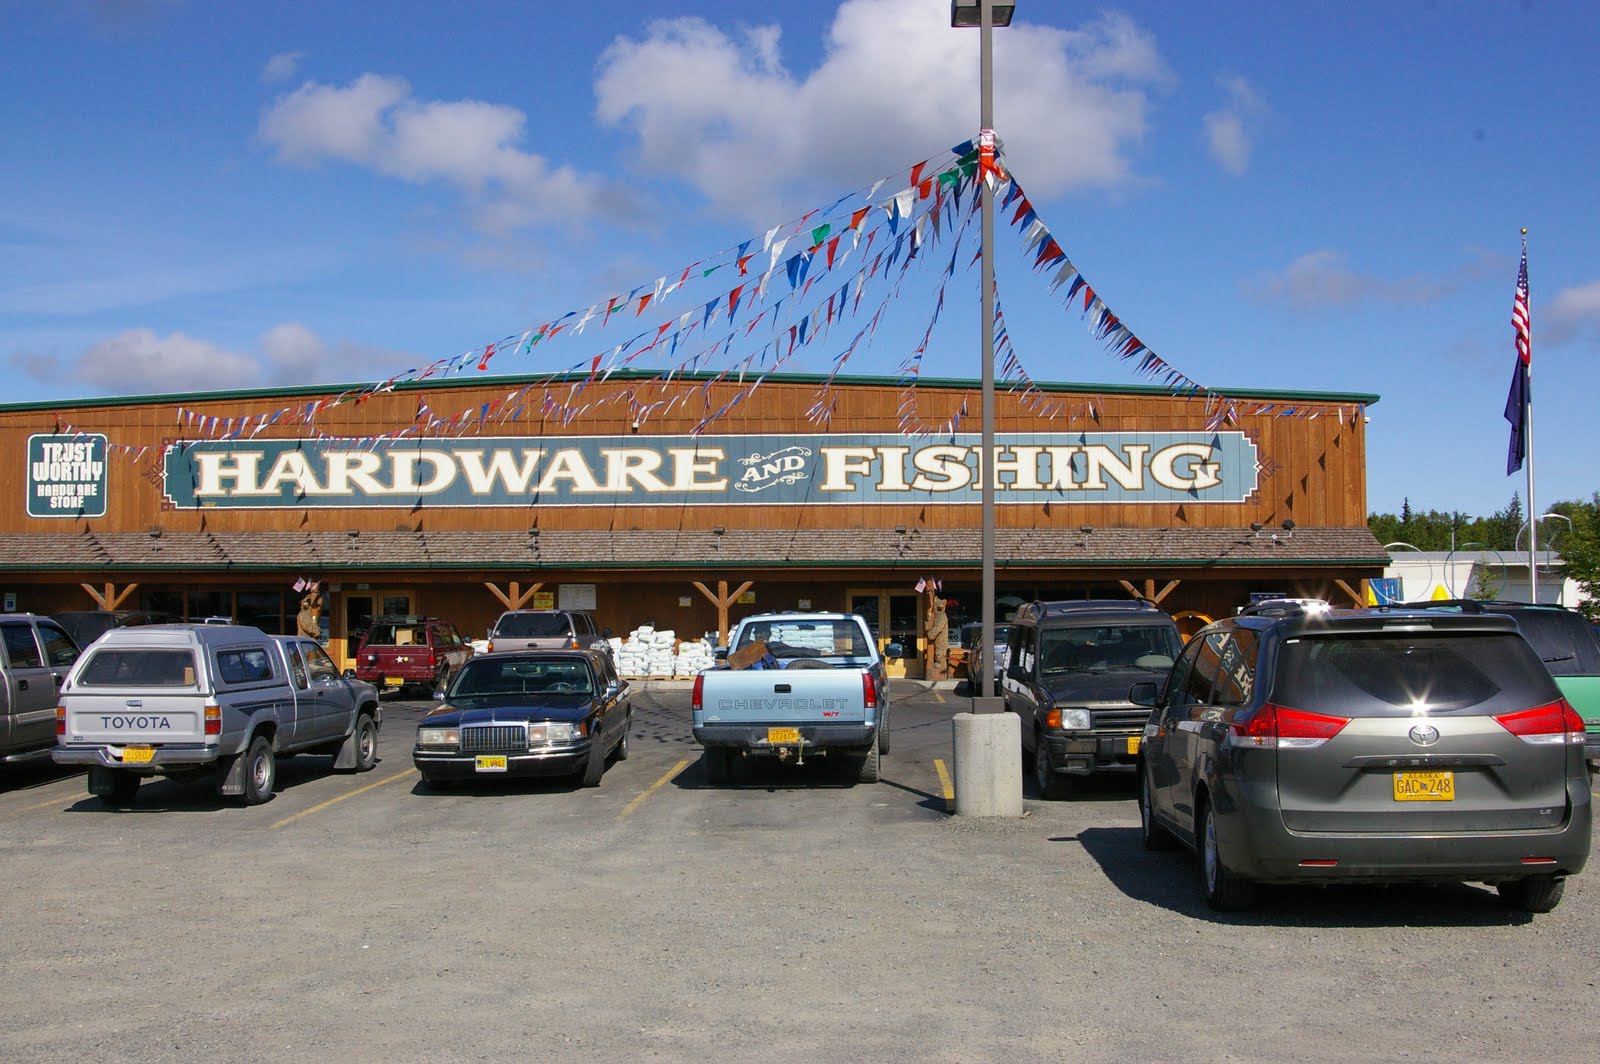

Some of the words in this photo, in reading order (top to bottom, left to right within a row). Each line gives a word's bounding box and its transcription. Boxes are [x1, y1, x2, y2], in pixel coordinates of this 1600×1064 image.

[42, 443, 95, 463] TRUST
[32, 461, 103, 482] WORTHY
[194, 448, 727, 497] HARDWARE
[741, 455, 806, 482] AND
[819, 444, 1223, 491] FISHING
[37, 484, 98, 497] HARDWARE
[50, 496, 84, 509] STORE
[718, 699, 849, 711] CHEVROLET
[100, 717, 171, 729] TOYOTA
[1396, 779, 1420, 794] GAC
[1429, 779, 1451, 793] 248
